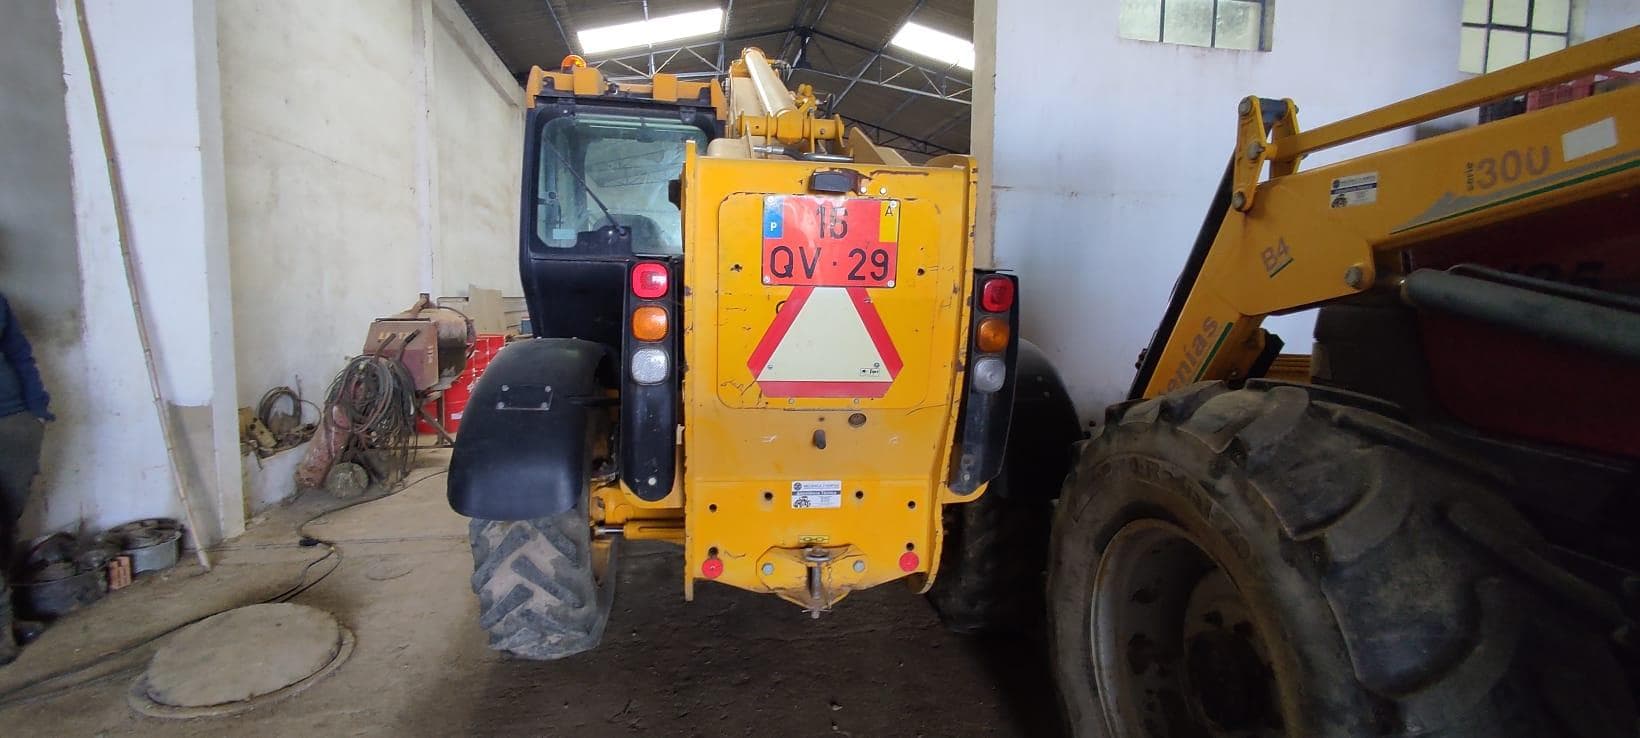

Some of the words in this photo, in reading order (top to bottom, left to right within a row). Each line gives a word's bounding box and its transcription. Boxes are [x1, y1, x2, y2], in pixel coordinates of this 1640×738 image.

[884, 205, 894, 217] A
[769, 222, 778, 232] P
[769, 245, 822, 280] QV
[847, 247, 889, 281] 29
[1260, 237, 1291, 272] B4
